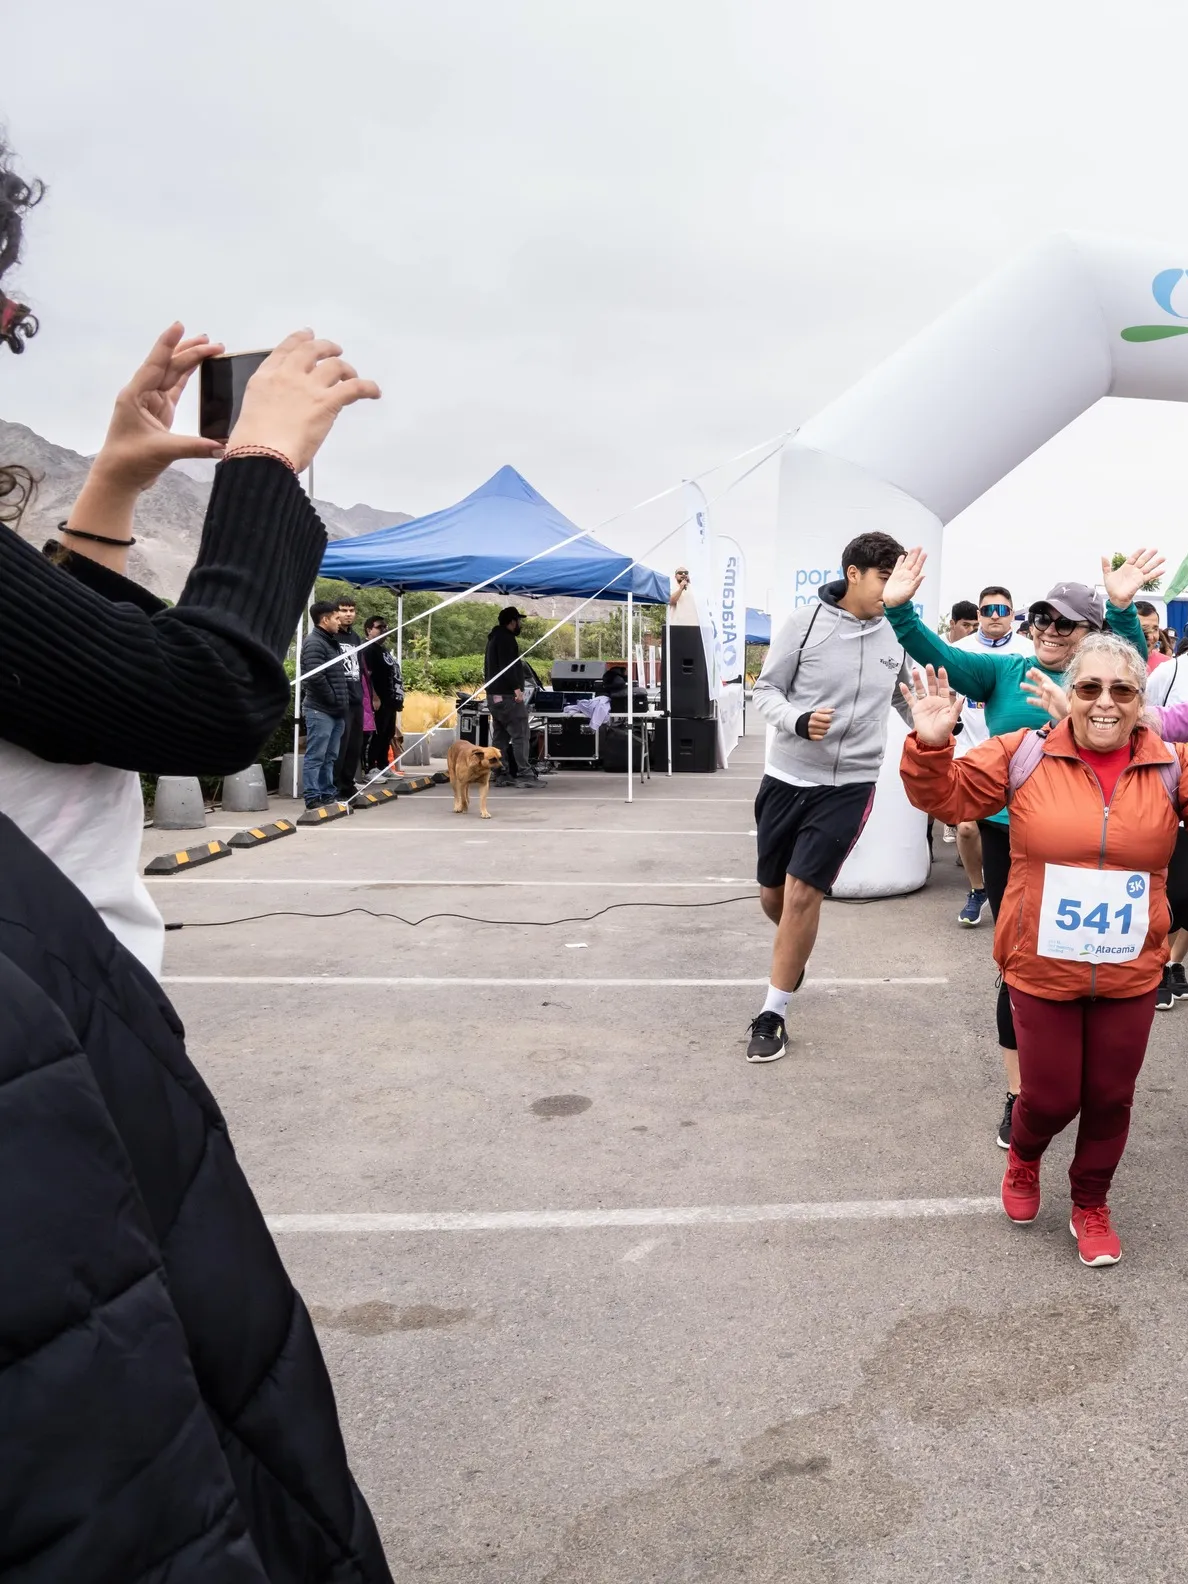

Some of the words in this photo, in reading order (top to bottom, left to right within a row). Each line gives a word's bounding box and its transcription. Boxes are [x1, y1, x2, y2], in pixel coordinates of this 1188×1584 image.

[795, 569, 831, 591] por
[1128, 879, 1144, 893] 3K
[1055, 898, 1133, 934] 541
[1094, 945, 1135, 954] Atacama
